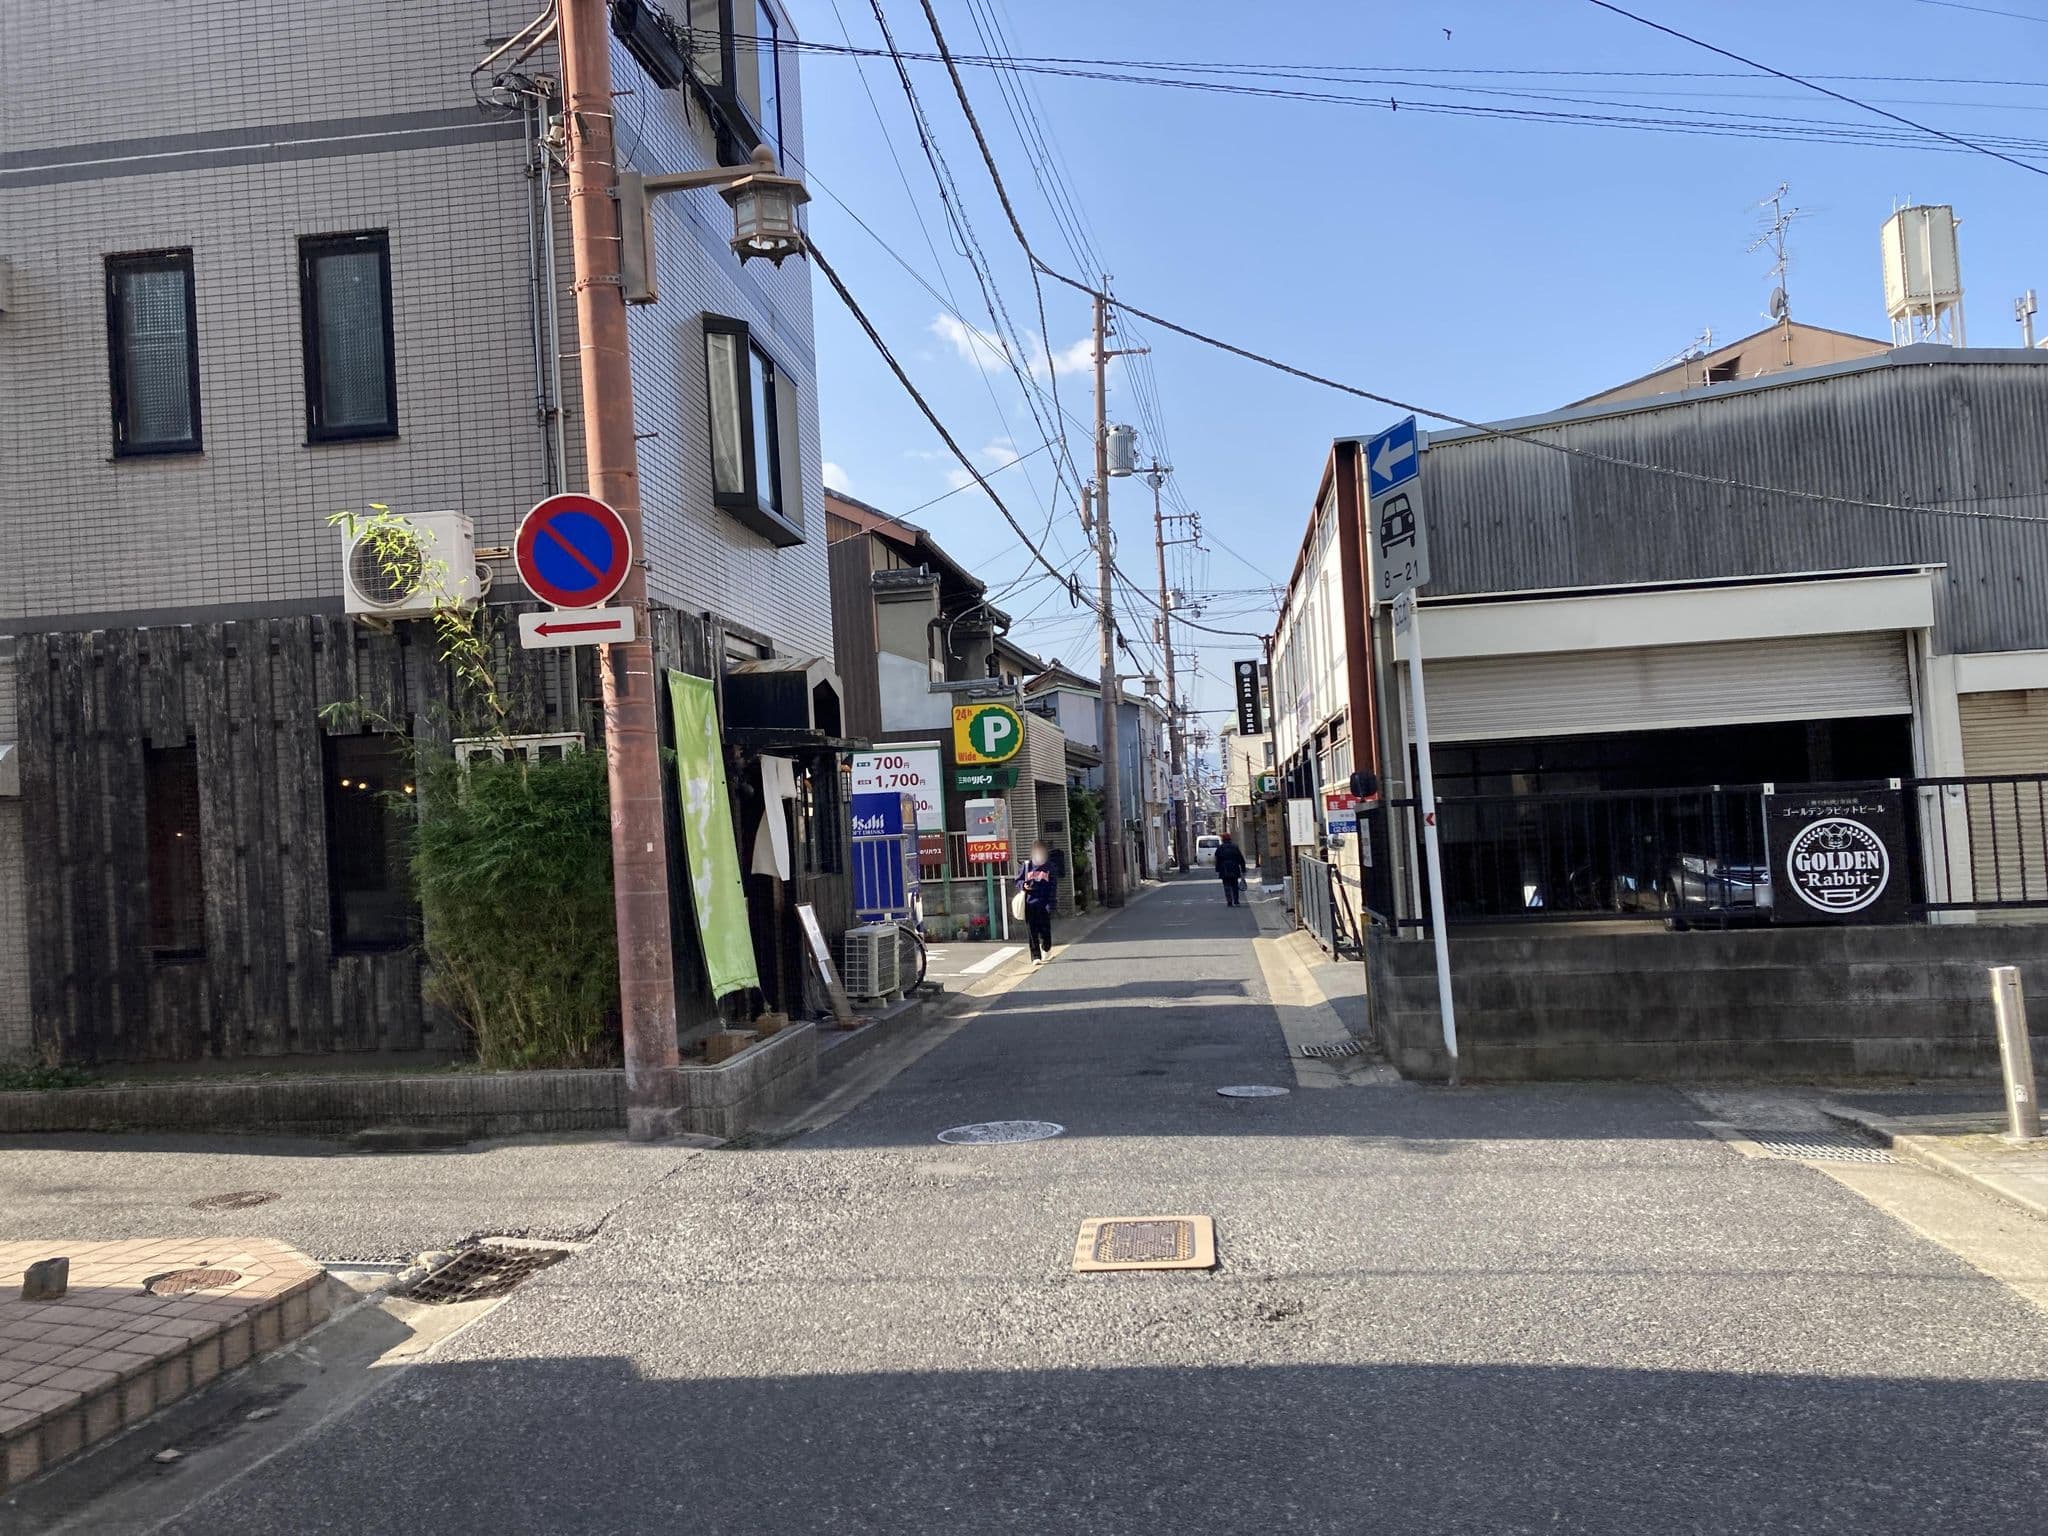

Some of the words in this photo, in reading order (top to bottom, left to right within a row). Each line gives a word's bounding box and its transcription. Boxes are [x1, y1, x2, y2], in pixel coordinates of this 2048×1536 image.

[983, 716, 1011, 752] P
[958, 751, 977, 761] Wide
[875, 773, 926, 789] 1,700円
[1783, 804, 1886, 816] ゴールデンラビットビール
[1796, 851, 1880, 872] GOLDEN
[1808, 871, 1870, 887] Rabbit
